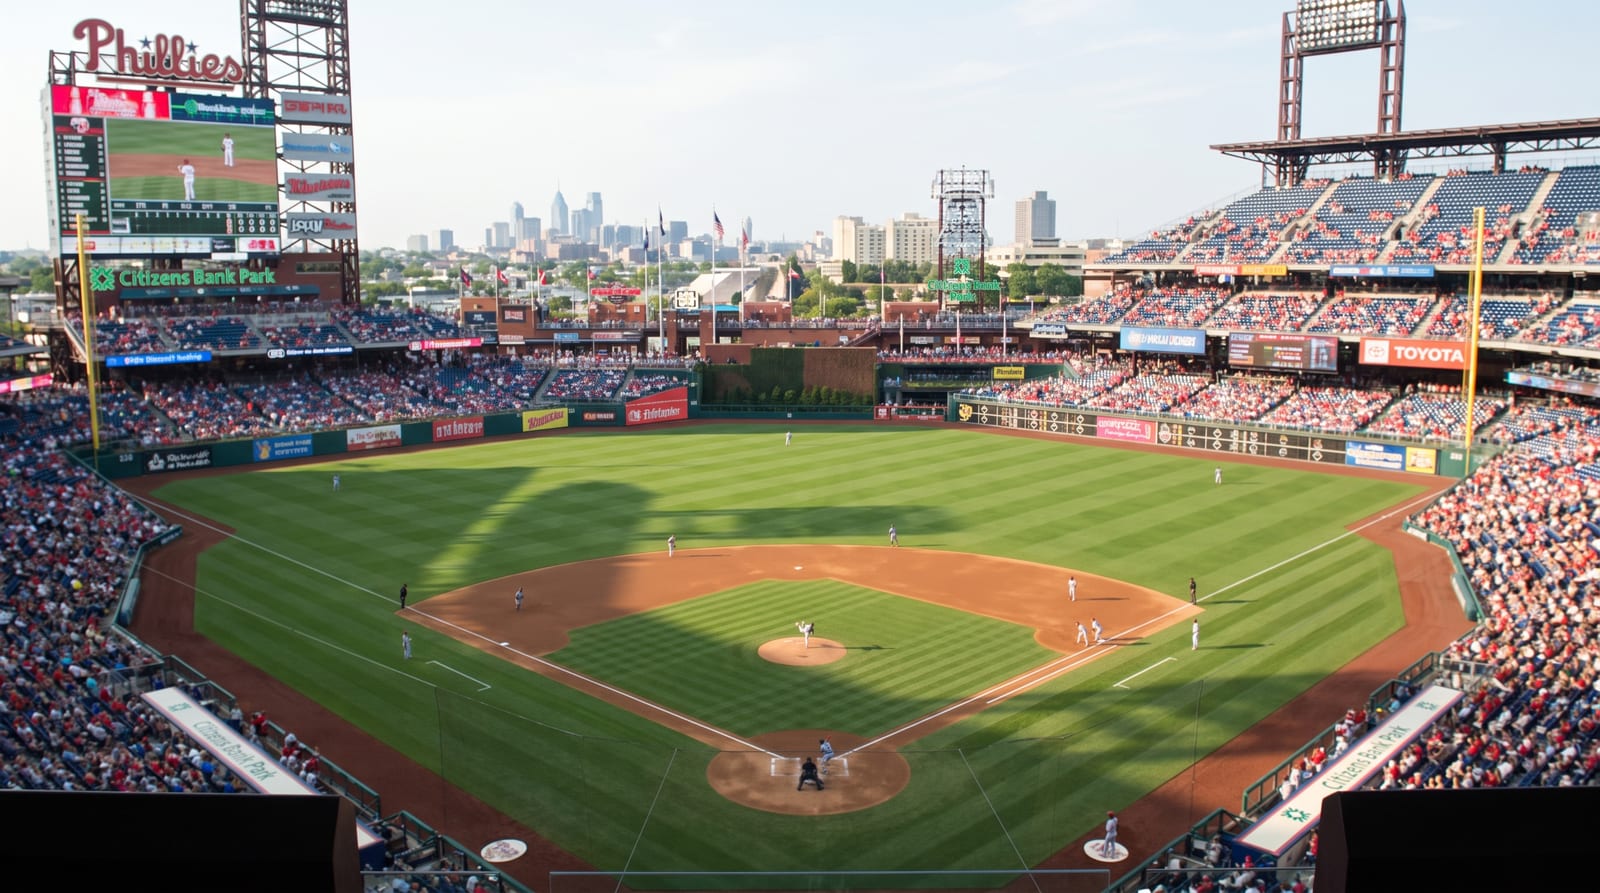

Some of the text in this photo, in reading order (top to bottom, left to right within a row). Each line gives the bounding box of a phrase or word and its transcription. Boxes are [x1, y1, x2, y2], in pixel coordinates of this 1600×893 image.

[73, 18, 243, 82] Phillies
[119, 266, 276, 287] Citizens Bank Park
[1393, 345, 1464, 363] TOYOTA
[1322, 725, 1411, 790] Citizens Bank Park
[243, 761, 278, 781] Park
